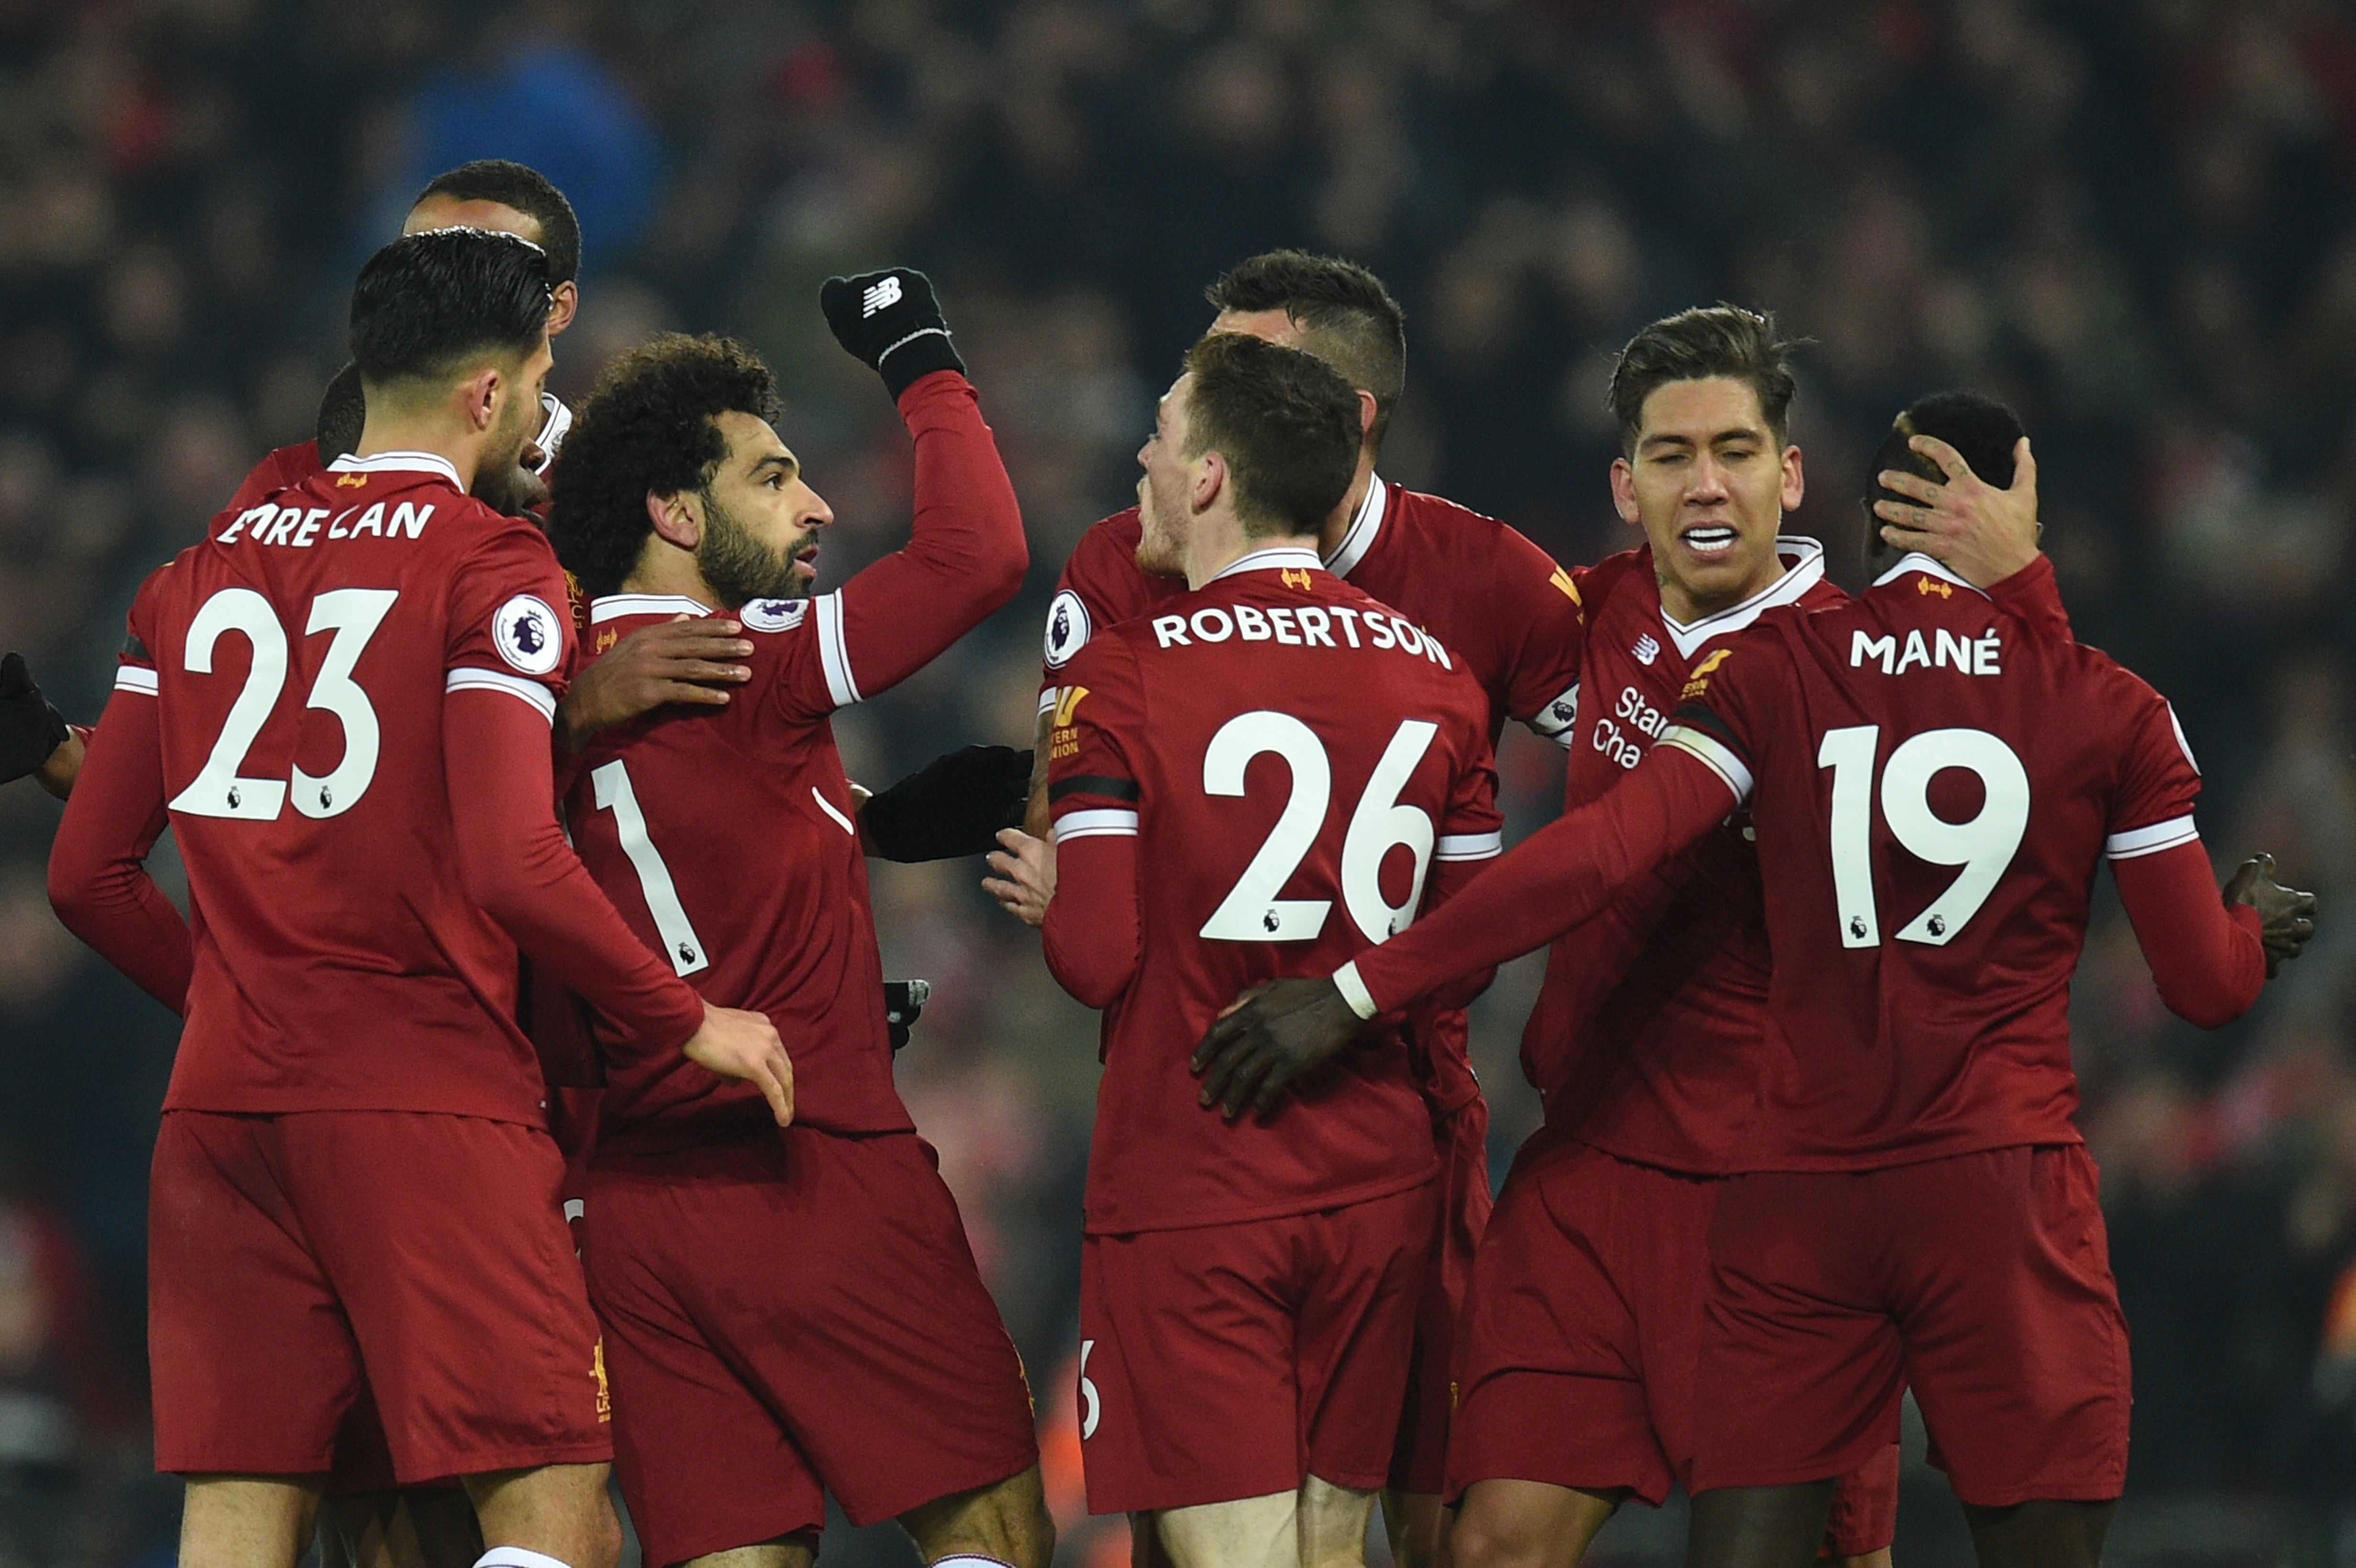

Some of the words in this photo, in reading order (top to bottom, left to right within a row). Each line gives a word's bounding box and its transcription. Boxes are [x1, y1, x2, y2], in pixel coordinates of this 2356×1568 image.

[167, 588, 399, 821] 23
[1152, 604, 1452, 670] ROBERTSON
[1592, 719, 1642, 769] Cha
[1850, 628, 2001, 675] MANÉ
[560, 759, 709, 978] 1
[1199, 710, 1439, 946] 26
[1817, 725, 2030, 948] 19
